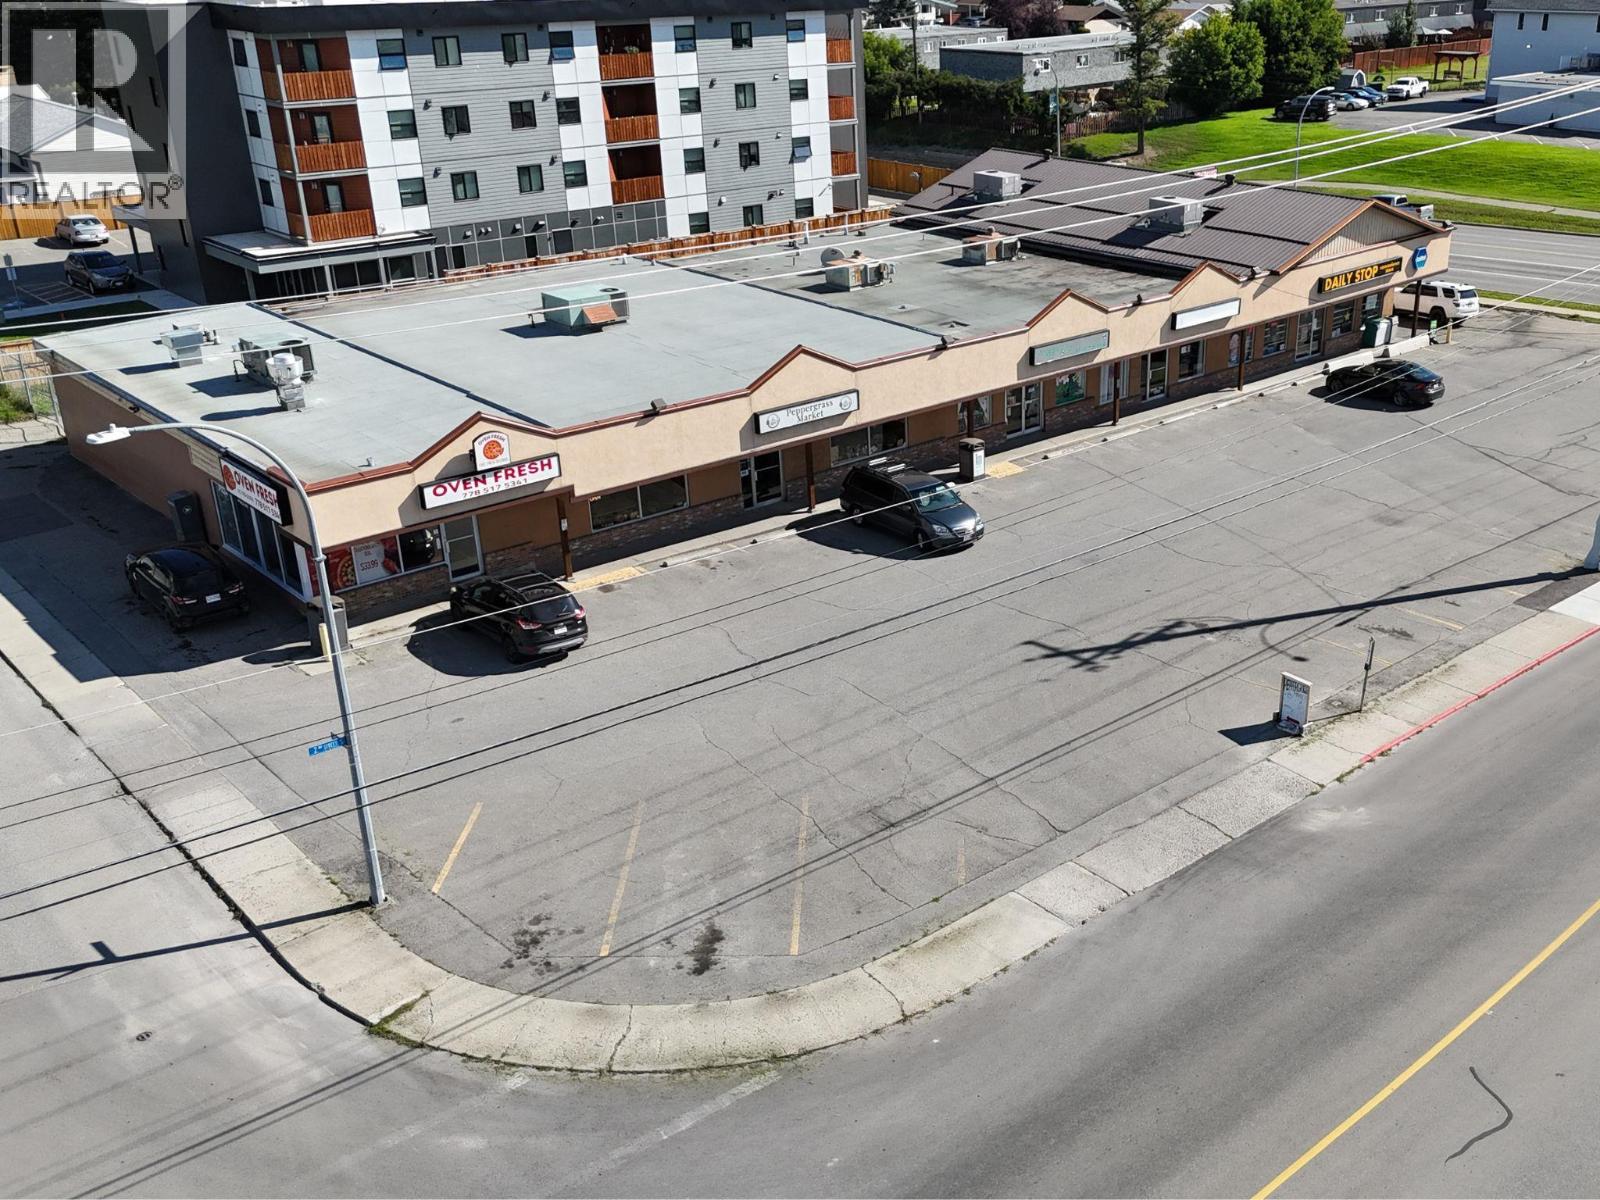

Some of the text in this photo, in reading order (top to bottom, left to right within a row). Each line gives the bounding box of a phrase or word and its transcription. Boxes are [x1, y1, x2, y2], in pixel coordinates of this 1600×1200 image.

[1325, 273, 1352, 291] DAILY
[1354, 265, 1379, 283] STOP
[786, 400, 834, 417] Peppergrass
[797, 410, 824, 422] Market
[233, 470, 255, 494] OVEN
[432, 474, 487, 497] OVEN
[493, 459, 553, 482] FRESH
[462, 489, 481, 498] 778
[483, 484, 501, 494] 517
